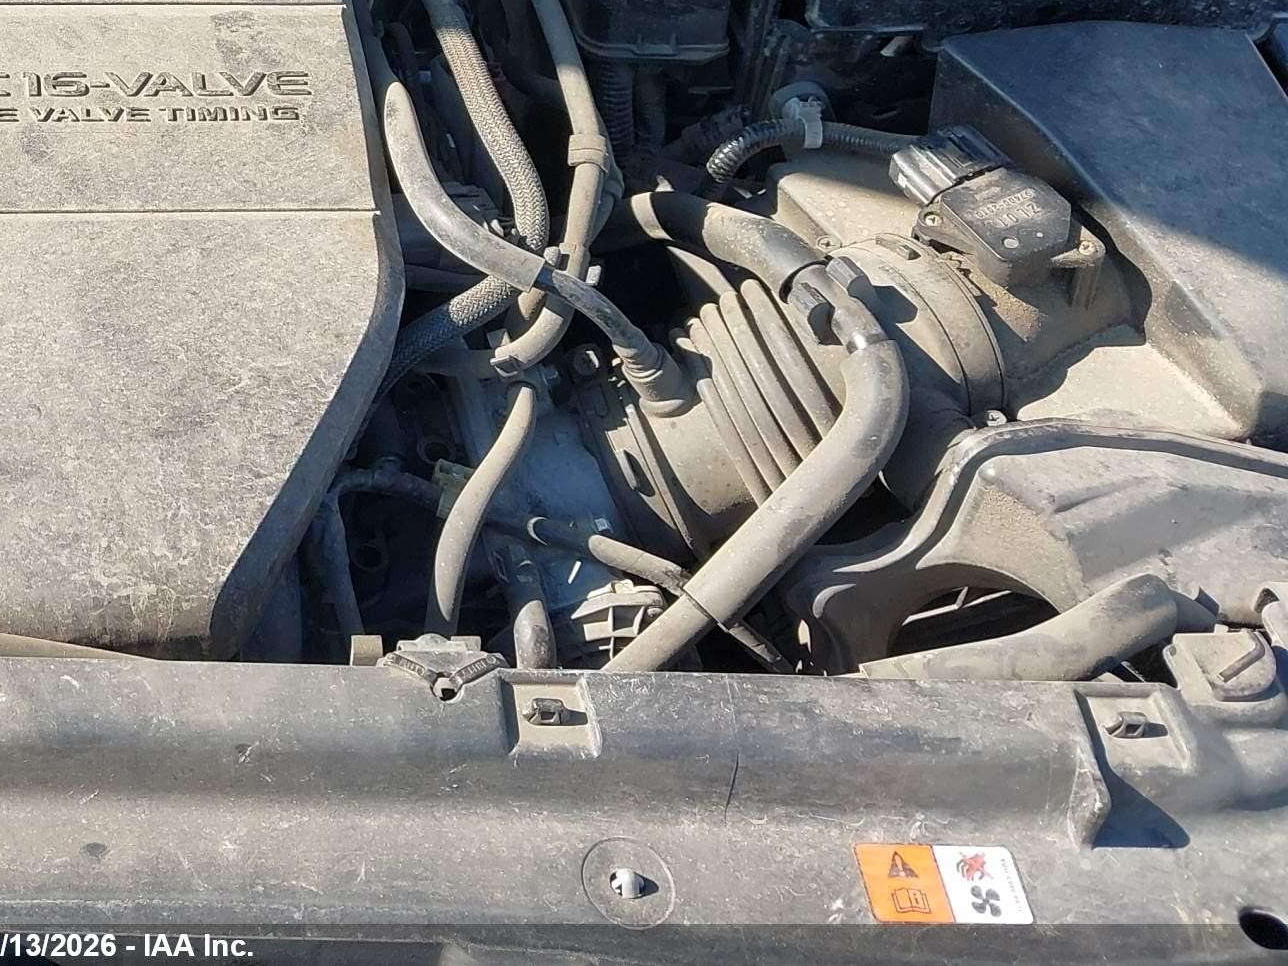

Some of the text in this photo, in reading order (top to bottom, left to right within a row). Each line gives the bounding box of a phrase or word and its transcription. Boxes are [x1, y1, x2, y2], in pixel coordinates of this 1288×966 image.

[22, 70, 313, 98] 16-VALVE
[30, 106, 152, 124] VALVE
[160, 105, 300, 122] TIMING
